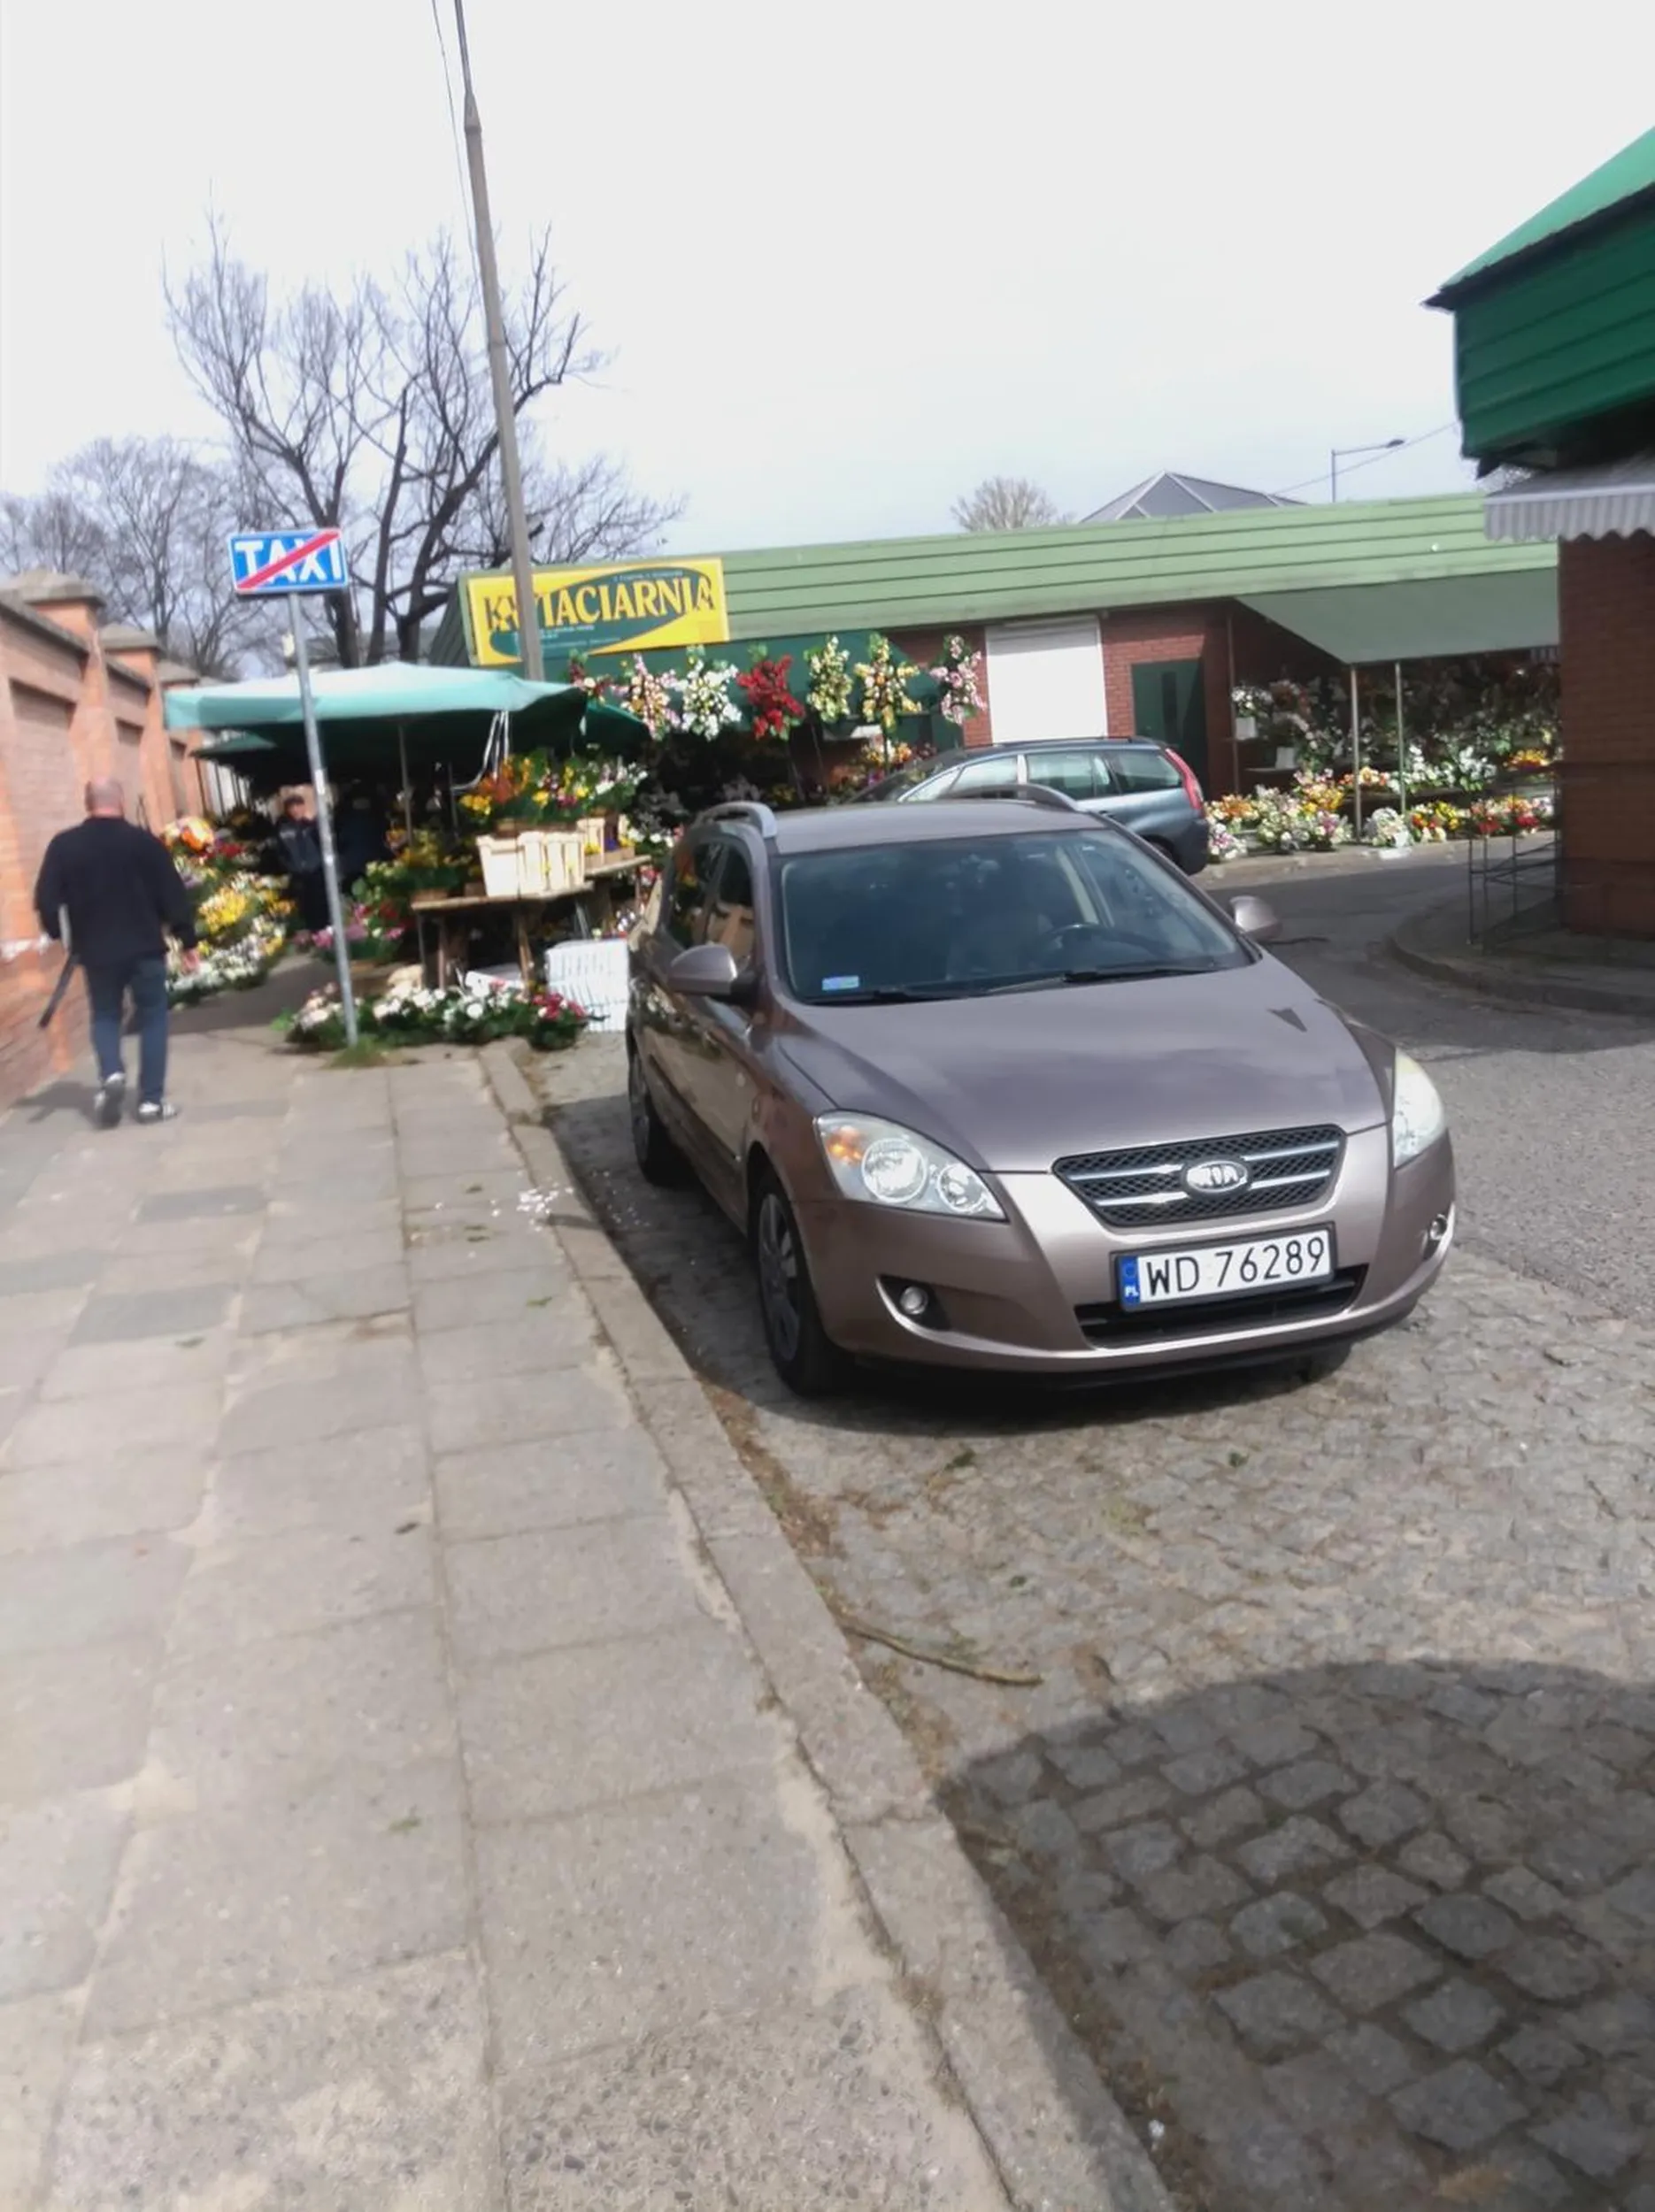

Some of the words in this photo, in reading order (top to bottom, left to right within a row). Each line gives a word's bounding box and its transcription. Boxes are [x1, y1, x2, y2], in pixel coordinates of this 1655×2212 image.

[235, 538, 343, 583] TAXI
[1146, 1256, 1200, 1296] WD
[1214, 1236, 1325, 1287] 76289
[1124, 1286, 1139, 1297] PL
